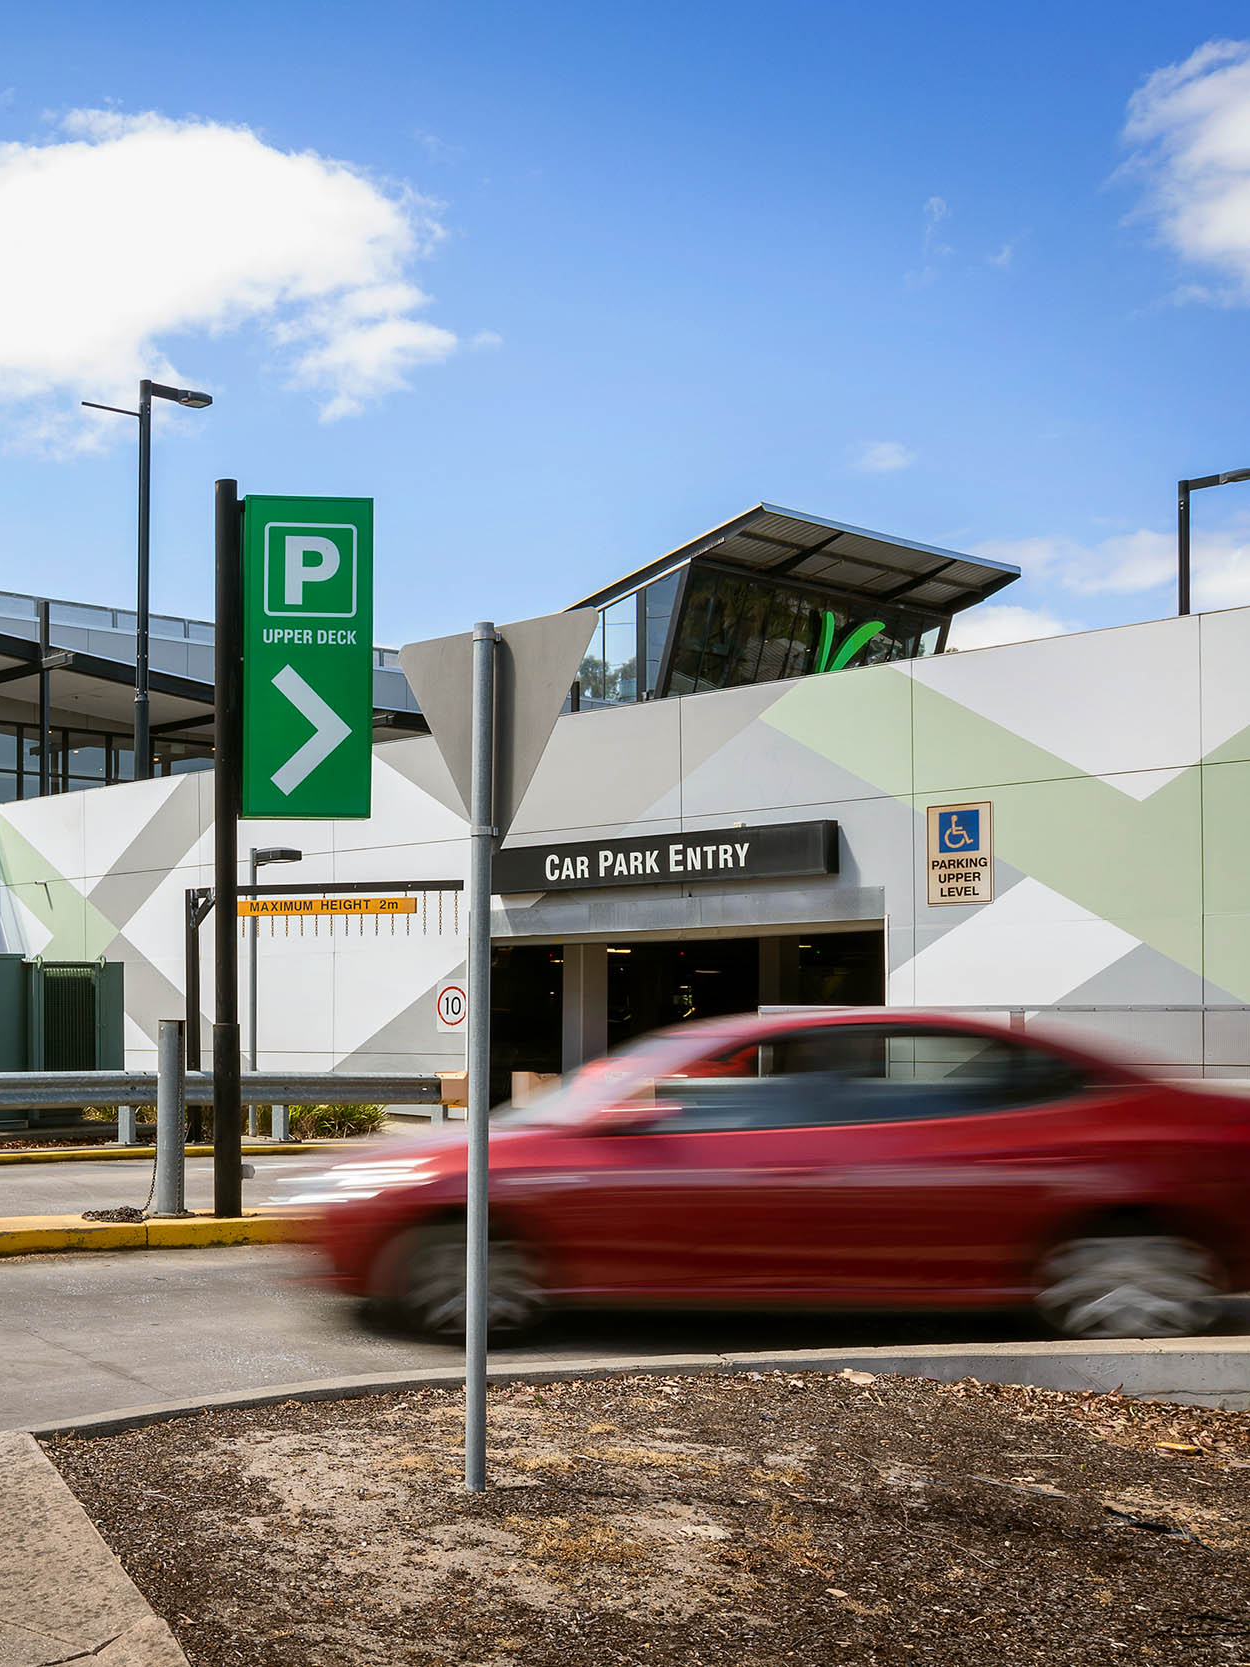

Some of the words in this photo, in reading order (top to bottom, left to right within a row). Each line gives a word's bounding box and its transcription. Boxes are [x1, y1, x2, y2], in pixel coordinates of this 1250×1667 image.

[285, 535, 340, 605] P
[263, 629, 313, 644] UPPER
[317, 630, 357, 645] DECK
[931, 857, 988, 870] PARKING
[938, 872, 981, 884] UPPER
[940, 886, 980, 898] LEVEL
[250, 901, 313, 912] MAXIMUM
[320, 899, 371, 910] HEIGHT
[379, 900, 399, 910] 2m
[445, 996, 461, 1015] 10
